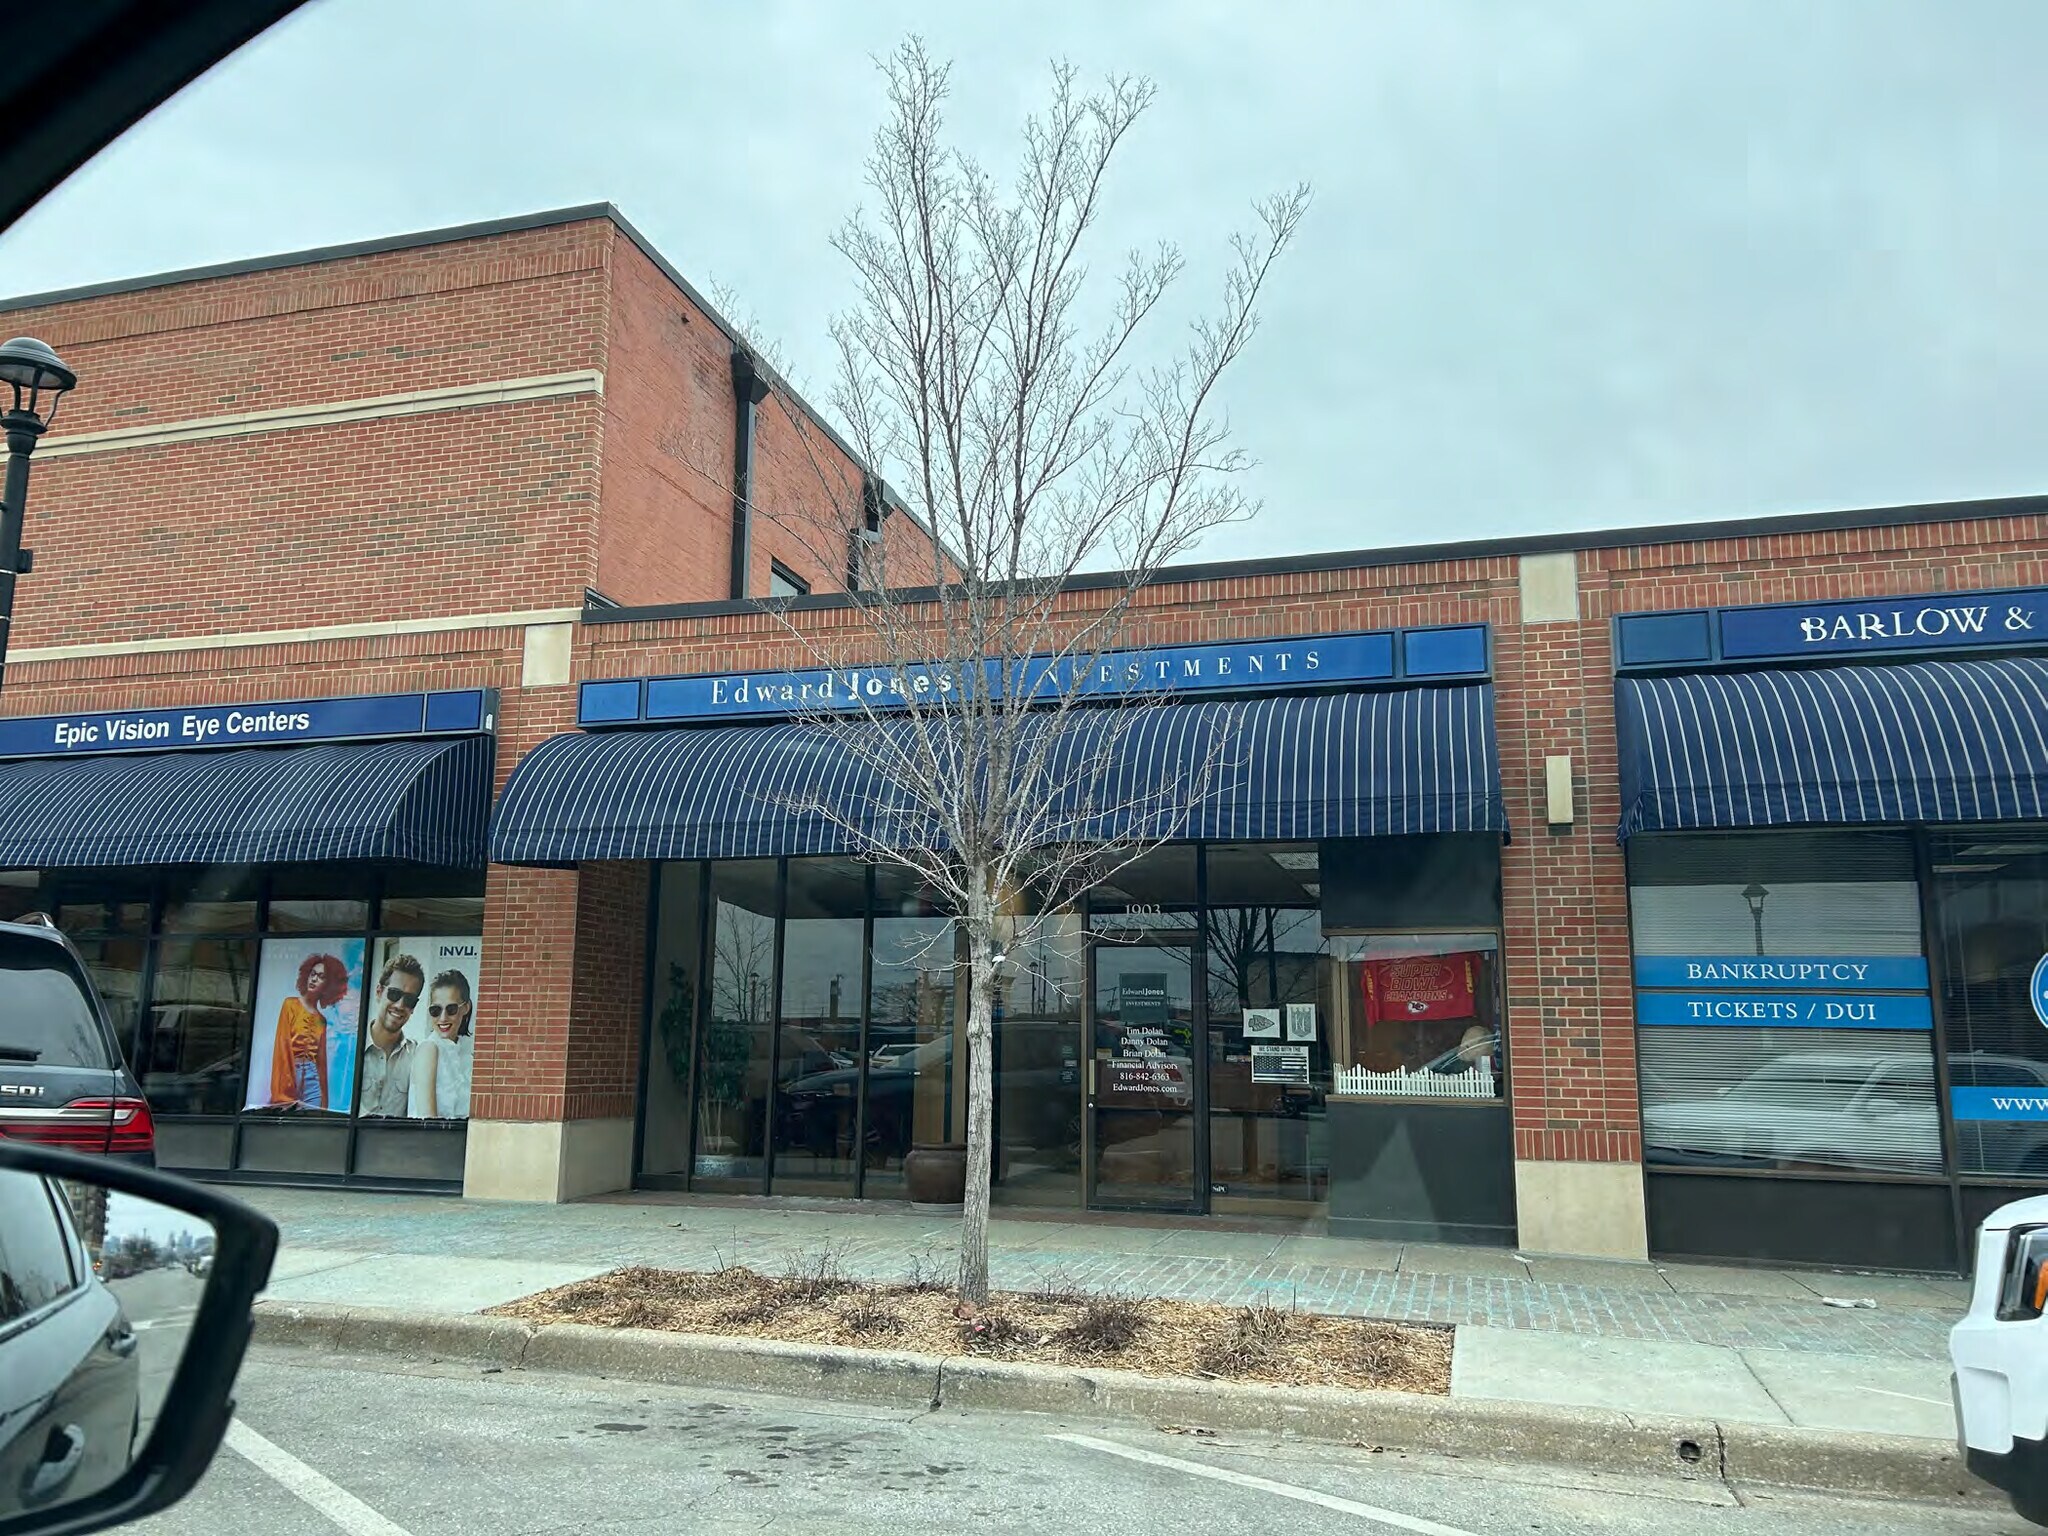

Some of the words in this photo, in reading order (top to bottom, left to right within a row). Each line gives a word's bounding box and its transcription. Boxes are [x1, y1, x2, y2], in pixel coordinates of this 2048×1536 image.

[1800, 606, 1990, 642] BARLOW
[2005, 606, 2037, 630] &
[711, 673, 835, 705] Edward
[54, 721, 98, 749] Epic
[105, 719, 170, 741] Vision
[182, 714, 220, 741] Eye
[226, 711, 310, 735] Centers
[1124, 903, 1161, 918] 1903
[1390, 963, 1442, 977] SUPER
[1687, 963, 1869, 981] BANKRUPTCY
[1390, 976, 1440, 991] BOWL
[1383, 989, 1448, 1002] CHAMPIONS
[1688, 1001, 1798, 1020] TICKETS
[1825, 1003, 1877, 1021] DUI
[1126, 1026, 1139, 1035] Tim
[1141, 1026, 1164, 1036] Dolan
[1120, 1036, 1144, 1047] Danny
[1146, 1037, 1168, 1047] Dolan
[1123, 1049, 1143, 1058] Brian
[1144, 1049, 1167, 1058] Dolan
[1111, 1060, 1145, 1070] Financial
[1146, 1060, 1178, 1070] Advisors
[1119, 1072, 1170, 1082] 816-842-6363
[1112, 1083, 1178, 1094] EdwardJones.com
